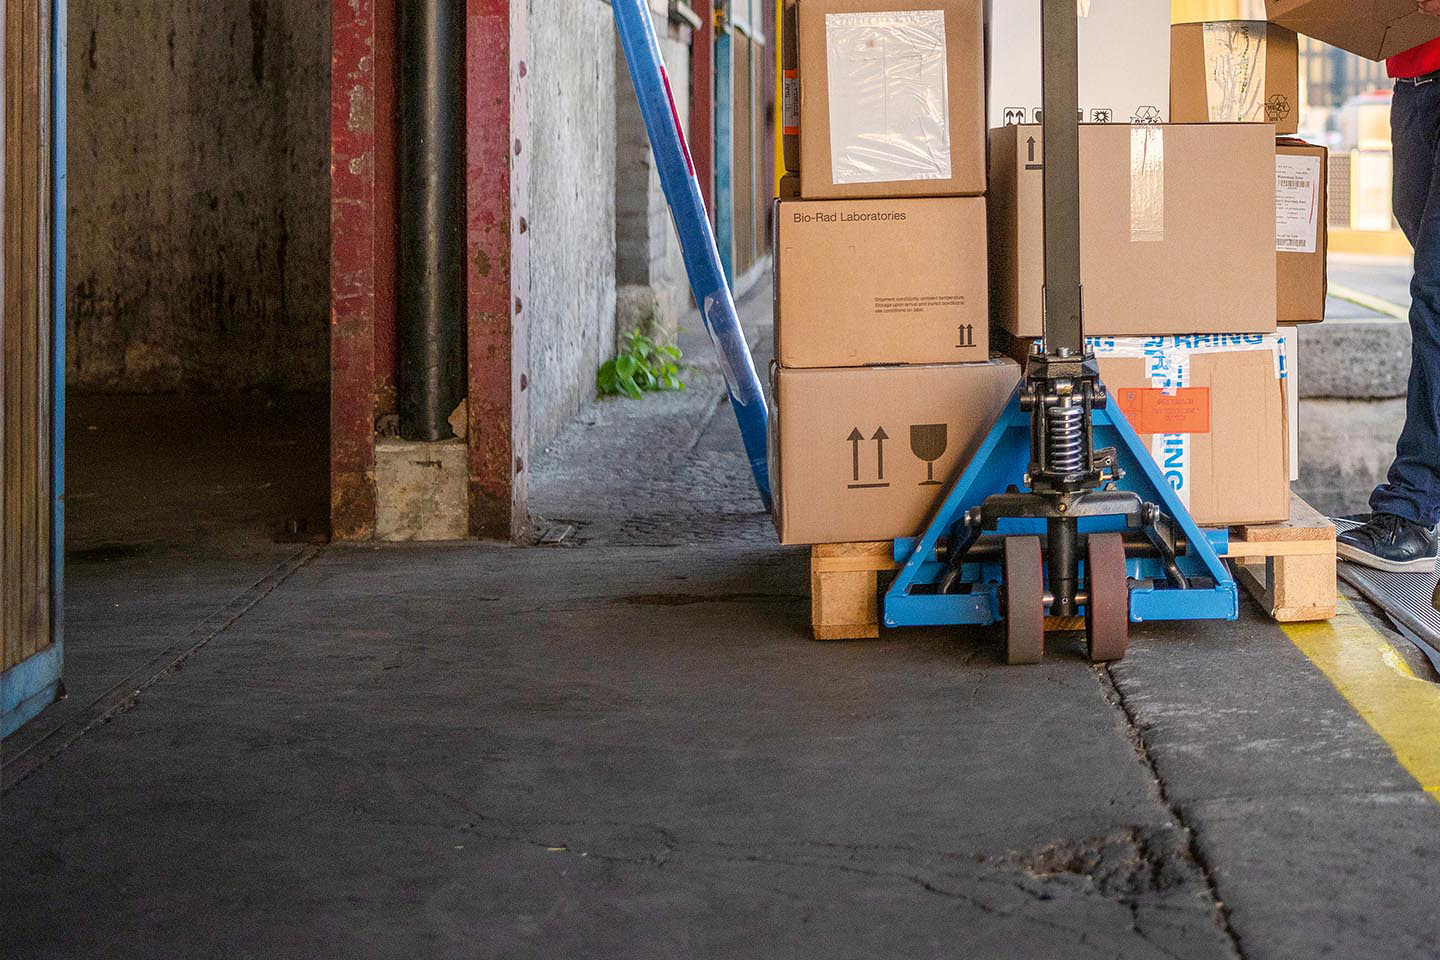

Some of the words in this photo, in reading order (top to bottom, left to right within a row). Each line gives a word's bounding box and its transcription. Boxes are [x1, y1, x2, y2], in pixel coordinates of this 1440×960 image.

[793, 212, 837, 223] Bio-Rad
[840, 211, 907, 222] Laboratories
[1163, 433, 1184, 491] ING
